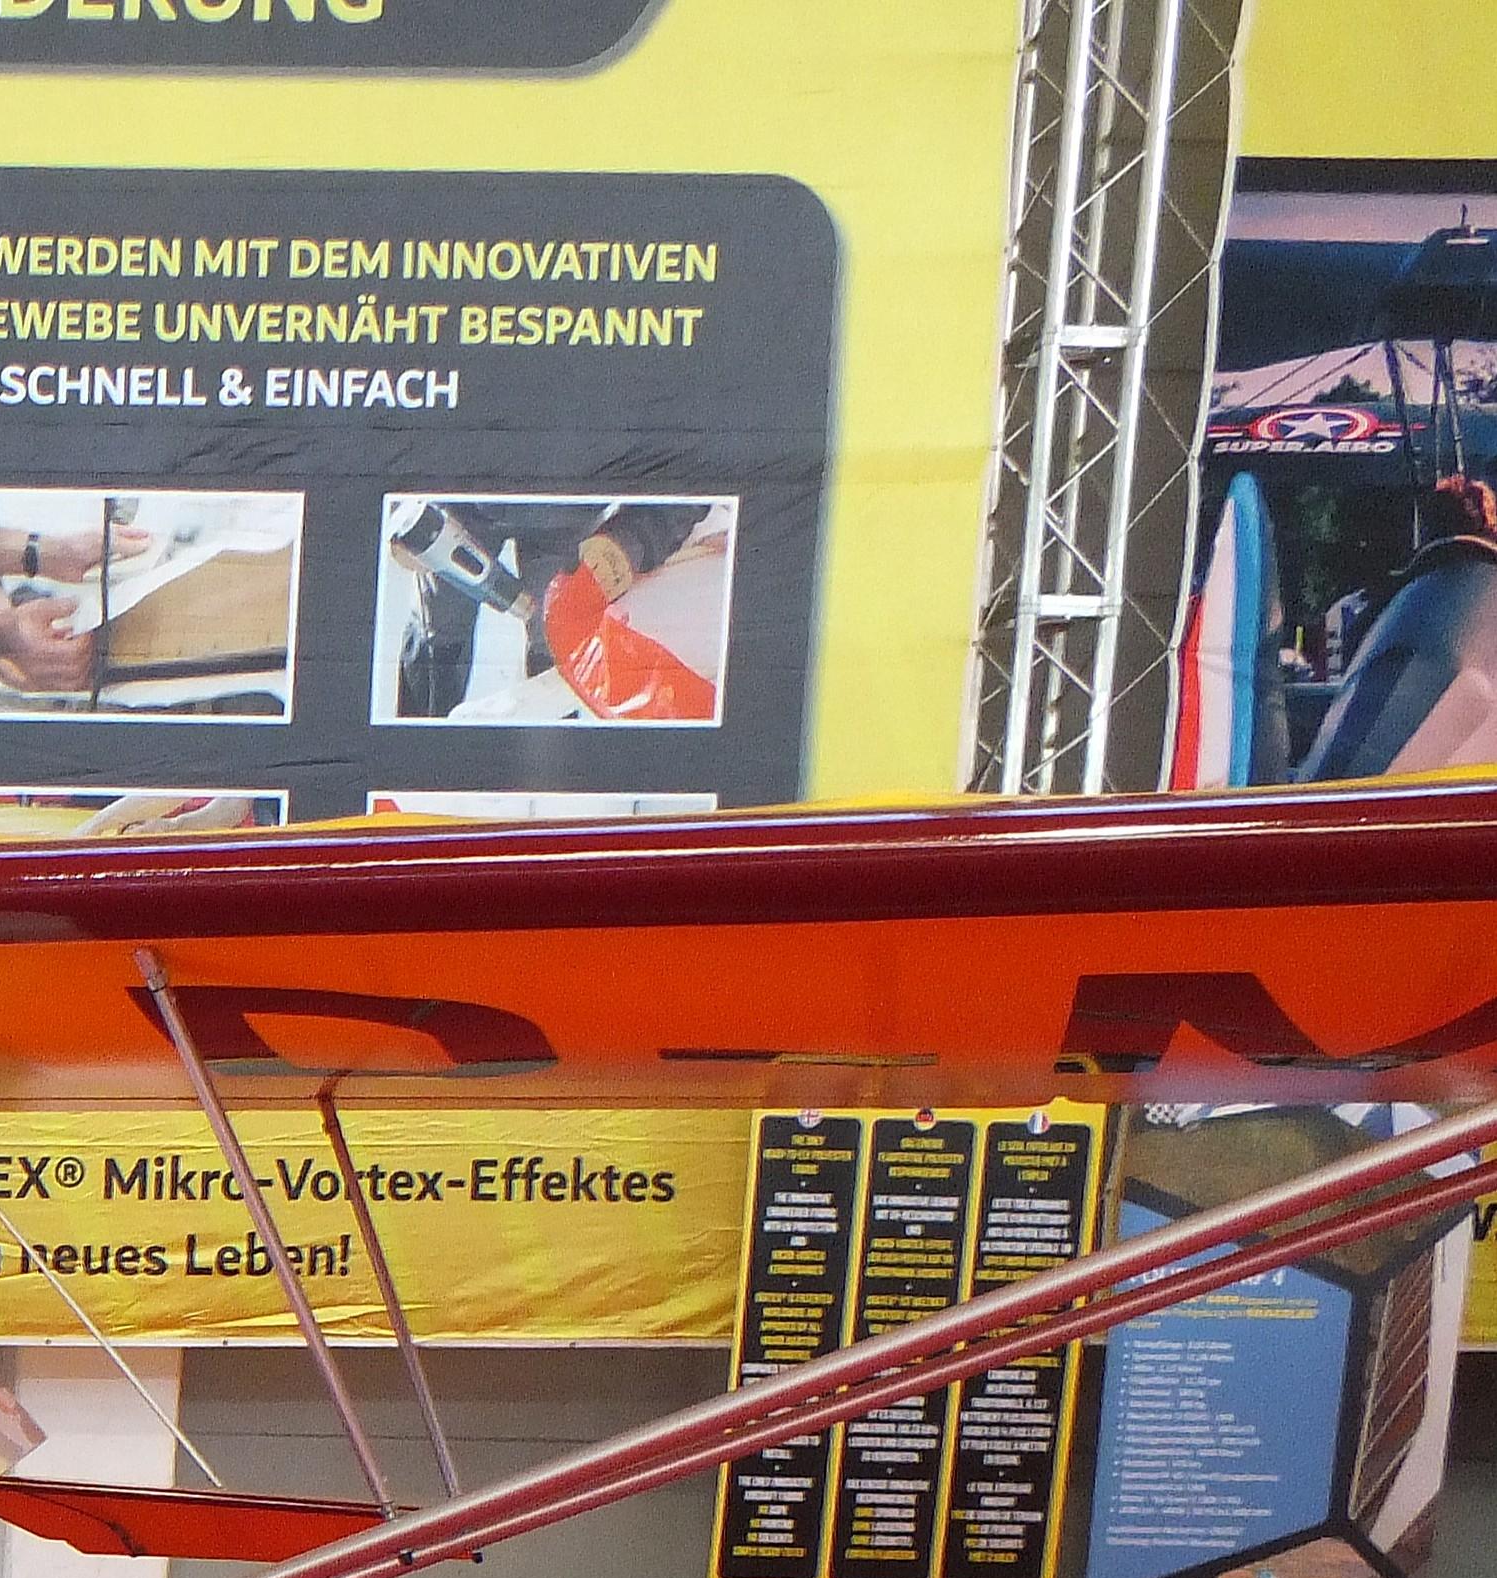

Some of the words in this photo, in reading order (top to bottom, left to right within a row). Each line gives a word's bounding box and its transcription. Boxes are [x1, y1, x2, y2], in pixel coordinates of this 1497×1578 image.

[195, 238, 280, 279] MIT
[290, 239, 391, 280] DEM
[403, 241, 718, 283] INNOVATIVEN
[155, 293, 450, 346] UNVERNÄHT
[460, 305, 705, 349] BESPANNT
[0, 364, 209, 408] SCHNELL
[219, 367, 254, 409] &
[266, 368, 461, 411] EINFACH
[21, 1240, 167, 1276] neues
[185, 1232, 352, 1278] Leben!
